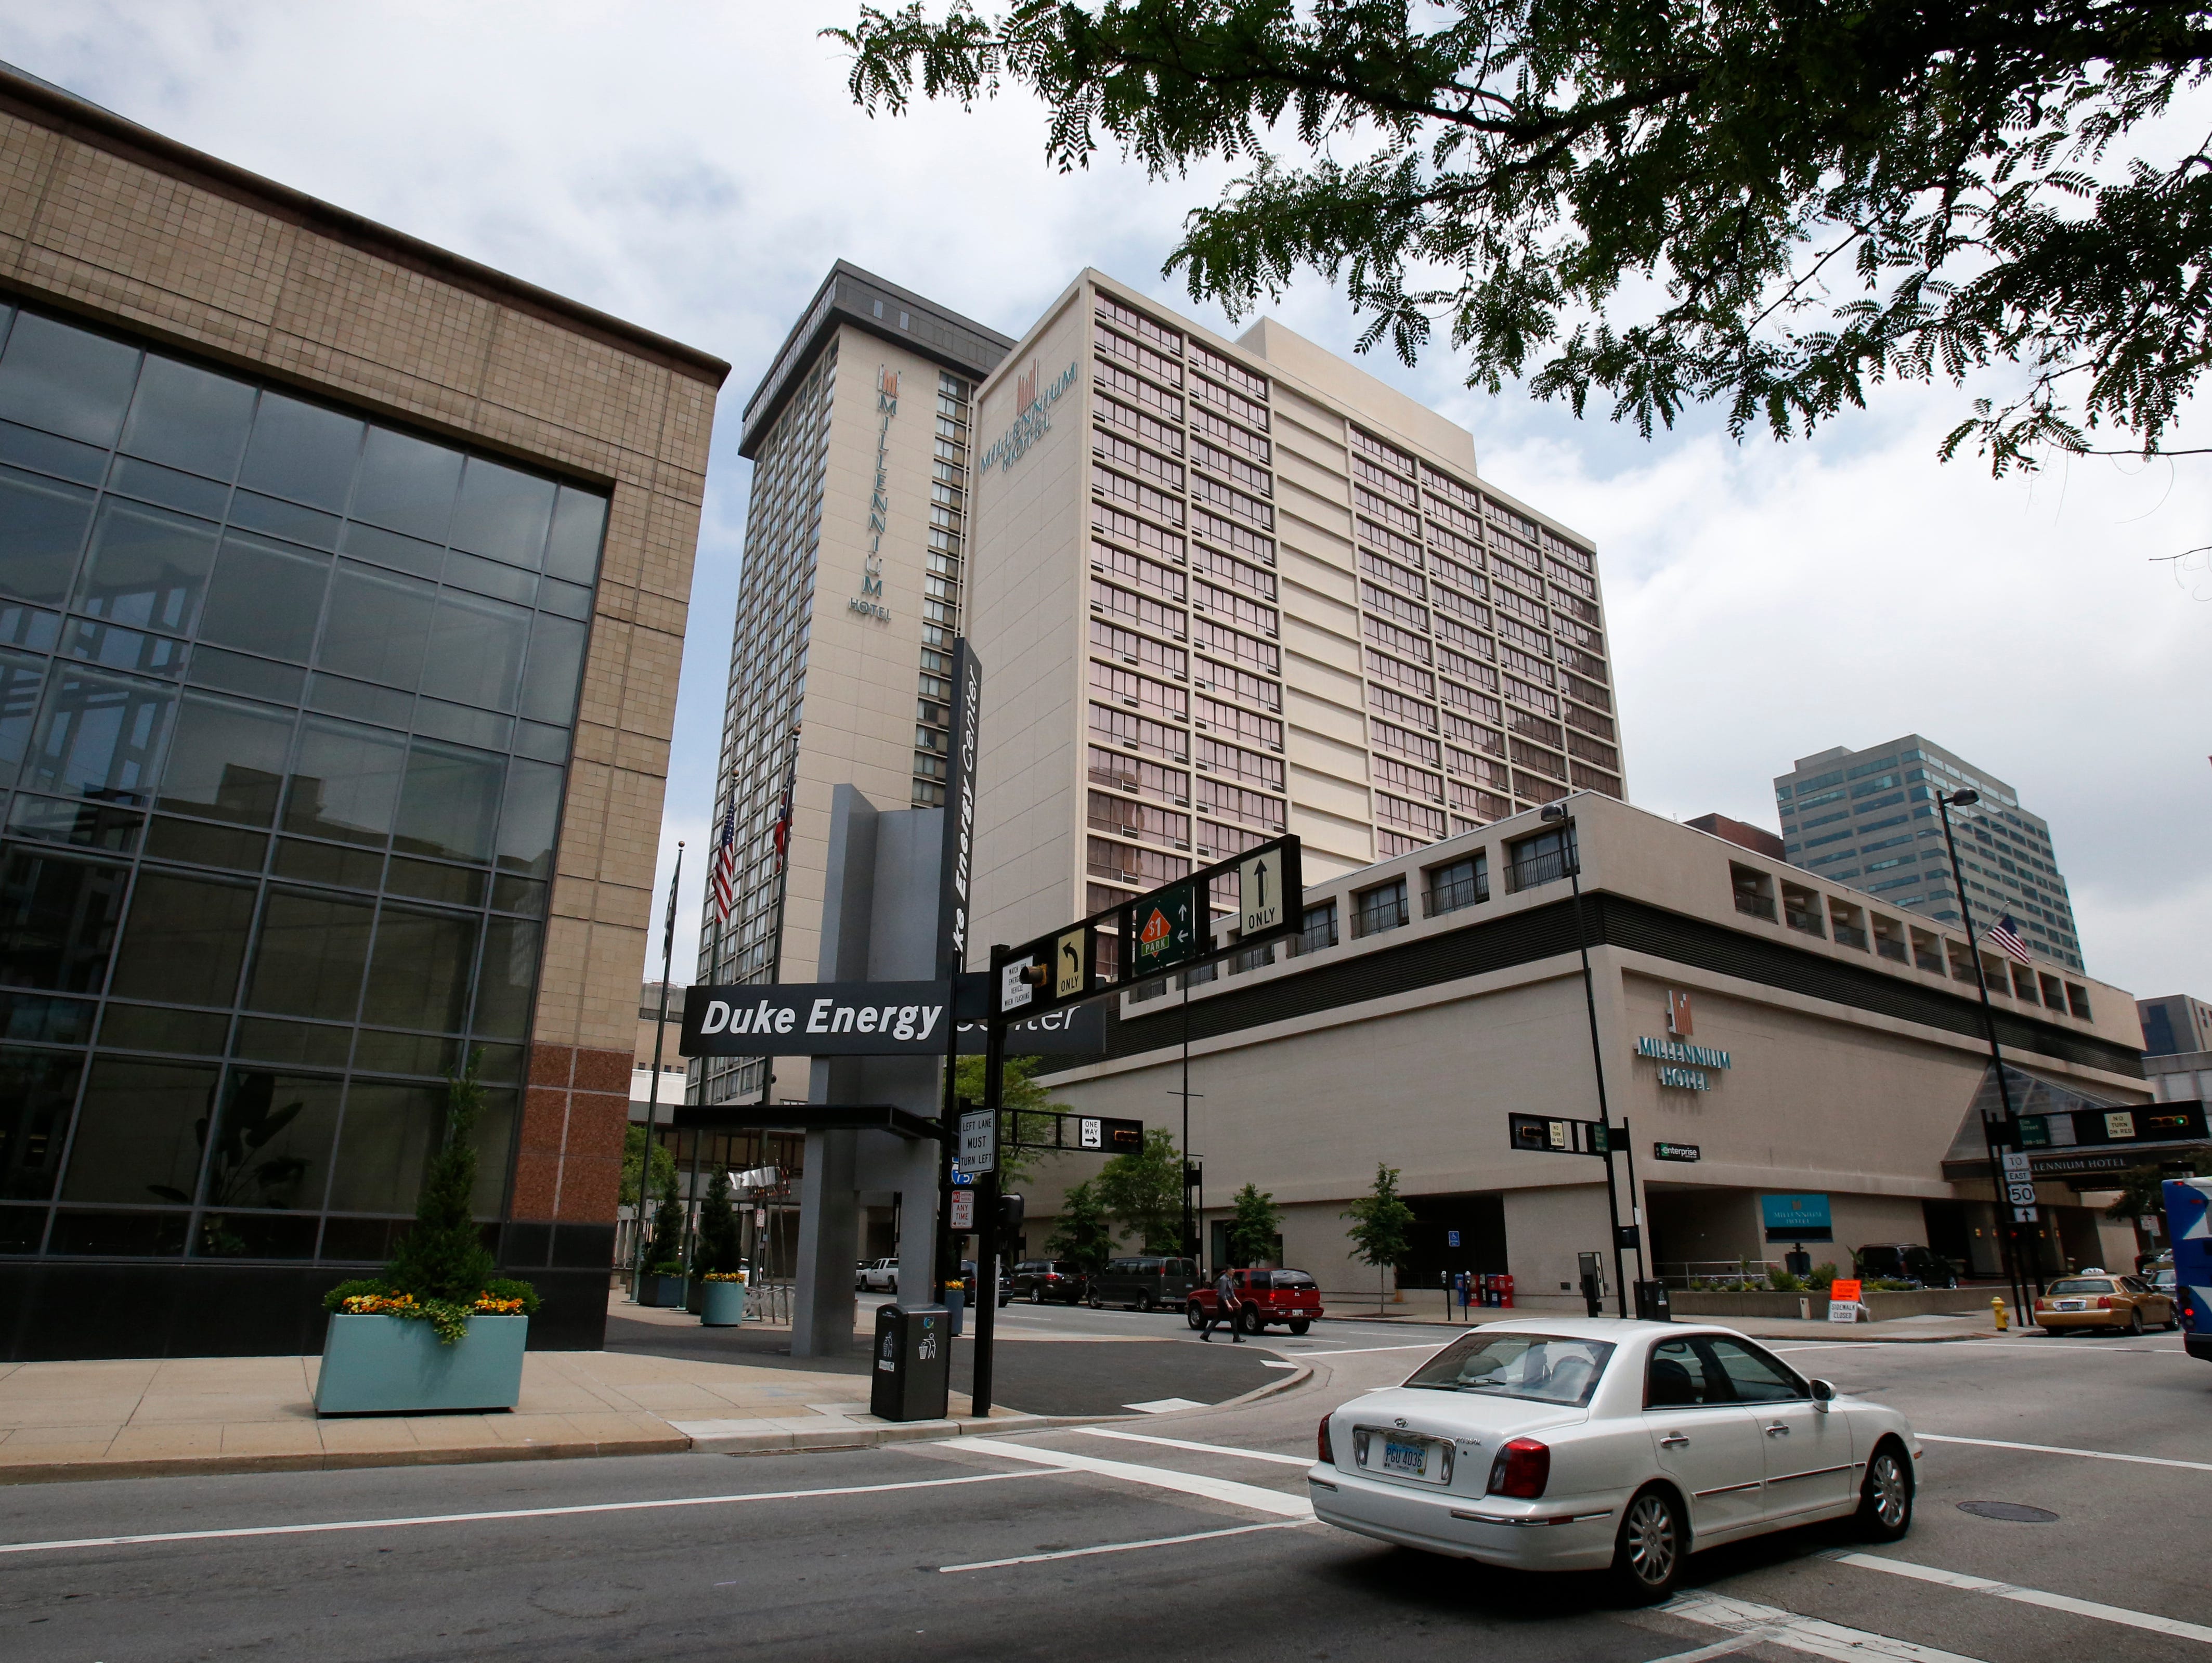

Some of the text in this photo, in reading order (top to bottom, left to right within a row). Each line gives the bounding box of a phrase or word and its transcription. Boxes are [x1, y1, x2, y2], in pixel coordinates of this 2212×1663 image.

[980, 361, 1077, 474] MILLENNIUM
[1003, 412, 1051, 472] HOTEL
[862, 394, 897, 597] MILLENNIUM
[849, 597, 891, 621] HOTEL
[962, 665, 978, 773] Center
[955, 775, 975, 902] Energy
[1149, 917, 1161, 937] $1
[1248, 907, 1275, 929] ONLY
[1146, 938, 1165, 954] PARK
[1009, 966, 1018, 975] WATCH
[1011, 984, 1023, 994] VEHICLE
[1061, 976, 1079, 992] ONLY
[1005, 992, 1030, 1007] WHEN FLASHING
[700, 999, 796, 1034] Duke
[805, 999, 942, 1040] Energy
[1638, 1036, 1731, 1069] MILLENNIUM
[1661, 1066, 1710, 1090] HOTEL
[963, 1118, 992, 1132] LEFT LANE
[968, 1136, 986, 1149] MUST
[961, 1153, 992, 1166] TURN LEFT
[1661, 1147, 1697, 1157] enterprise
[2009, 1158, 2022, 1166] TO
[2088, 1158, 2126, 1168] HOTEL
[2011, 1188, 2032, 1201] 50
[1385, 1447, 1423, 1467] PGU 4036
